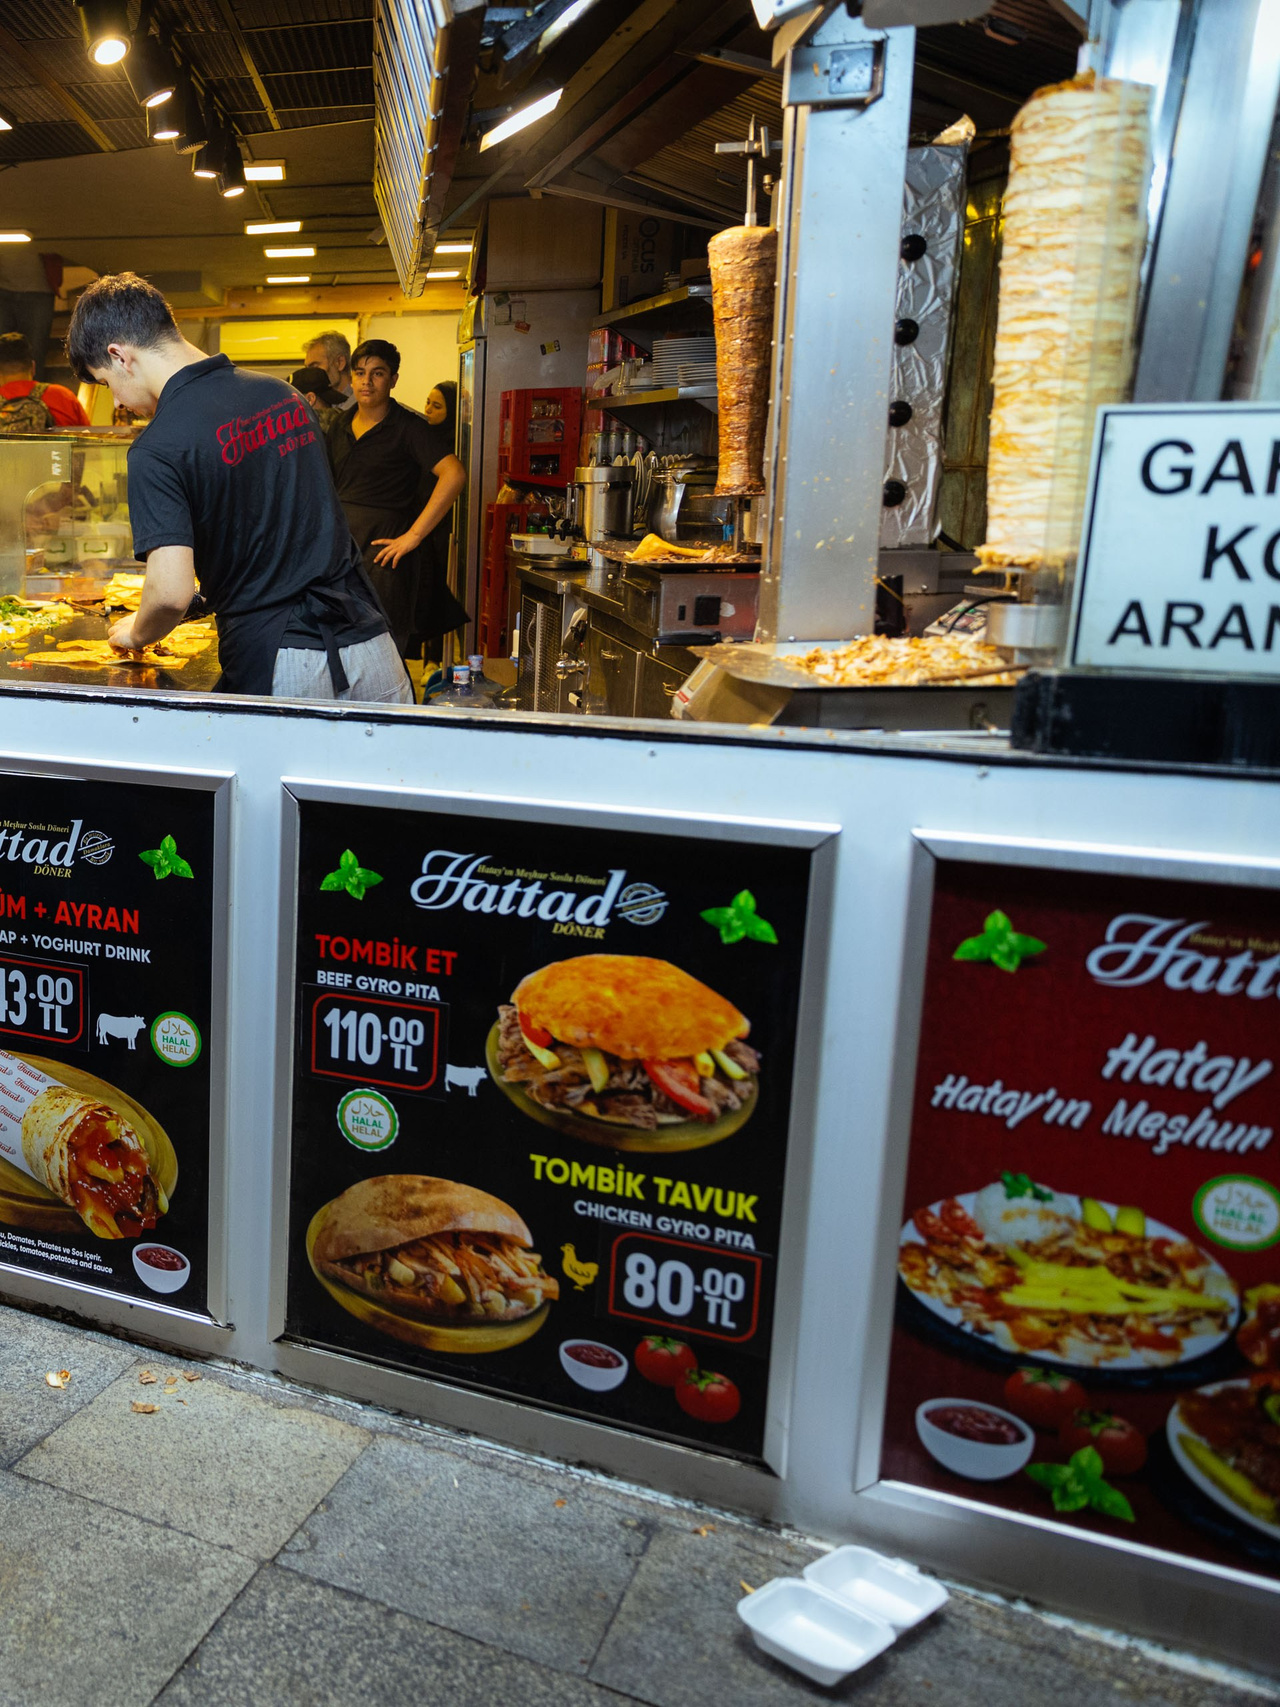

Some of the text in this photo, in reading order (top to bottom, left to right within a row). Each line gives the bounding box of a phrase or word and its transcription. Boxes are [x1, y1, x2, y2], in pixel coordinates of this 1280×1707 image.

[639, 218, 660, 274] OCUS
[3, 820, 27, 830] Meşhur
[28, 822, 46, 831] Soslu
[47, 823, 70, 834] Döneri
[33, 864, 72, 878] DÖNER
[410, 849, 627, 927] Hattad
[54, 901, 140, 935] AYRAN
[552, 921, 606, 940] DÖNER
[31, 934, 101, 958] YOGHURT
[105, 944, 151, 964] DRINK
[315, 934, 458, 976] TOMBİK ET
[1086, 913, 1280, 1000] Hatt
[316, 970, 441, 1001] BEEF GYRO PITA
[39, 1001, 68, 1034] TL
[162, 1035, 191, 1049] HALAL
[162, 1043, 190, 1056] HELAL
[389, 1040, 419, 1073] TL
[1102, 1032, 1273, 1110] Hatay
[351, 1114, 384, 1130] HALAL
[351, 1123, 383, 1139] HELAL
[930, 1074, 1273, 1155] Hatay'ın Meşhur
[529, 1153, 759, 1224] TOMBİK TAVUK
[573, 1200, 756, 1250] CHICKEN GYRO PITA
[7, 1232, 36, 1247] Domates,
[38, 1239, 61, 1252] Patates
[72, 1248, 83, 1258] Sos
[79, 1260, 93, 1269] and
[93, 1264, 113, 1275] sauce
[703, 1293, 737, 1330] TL
